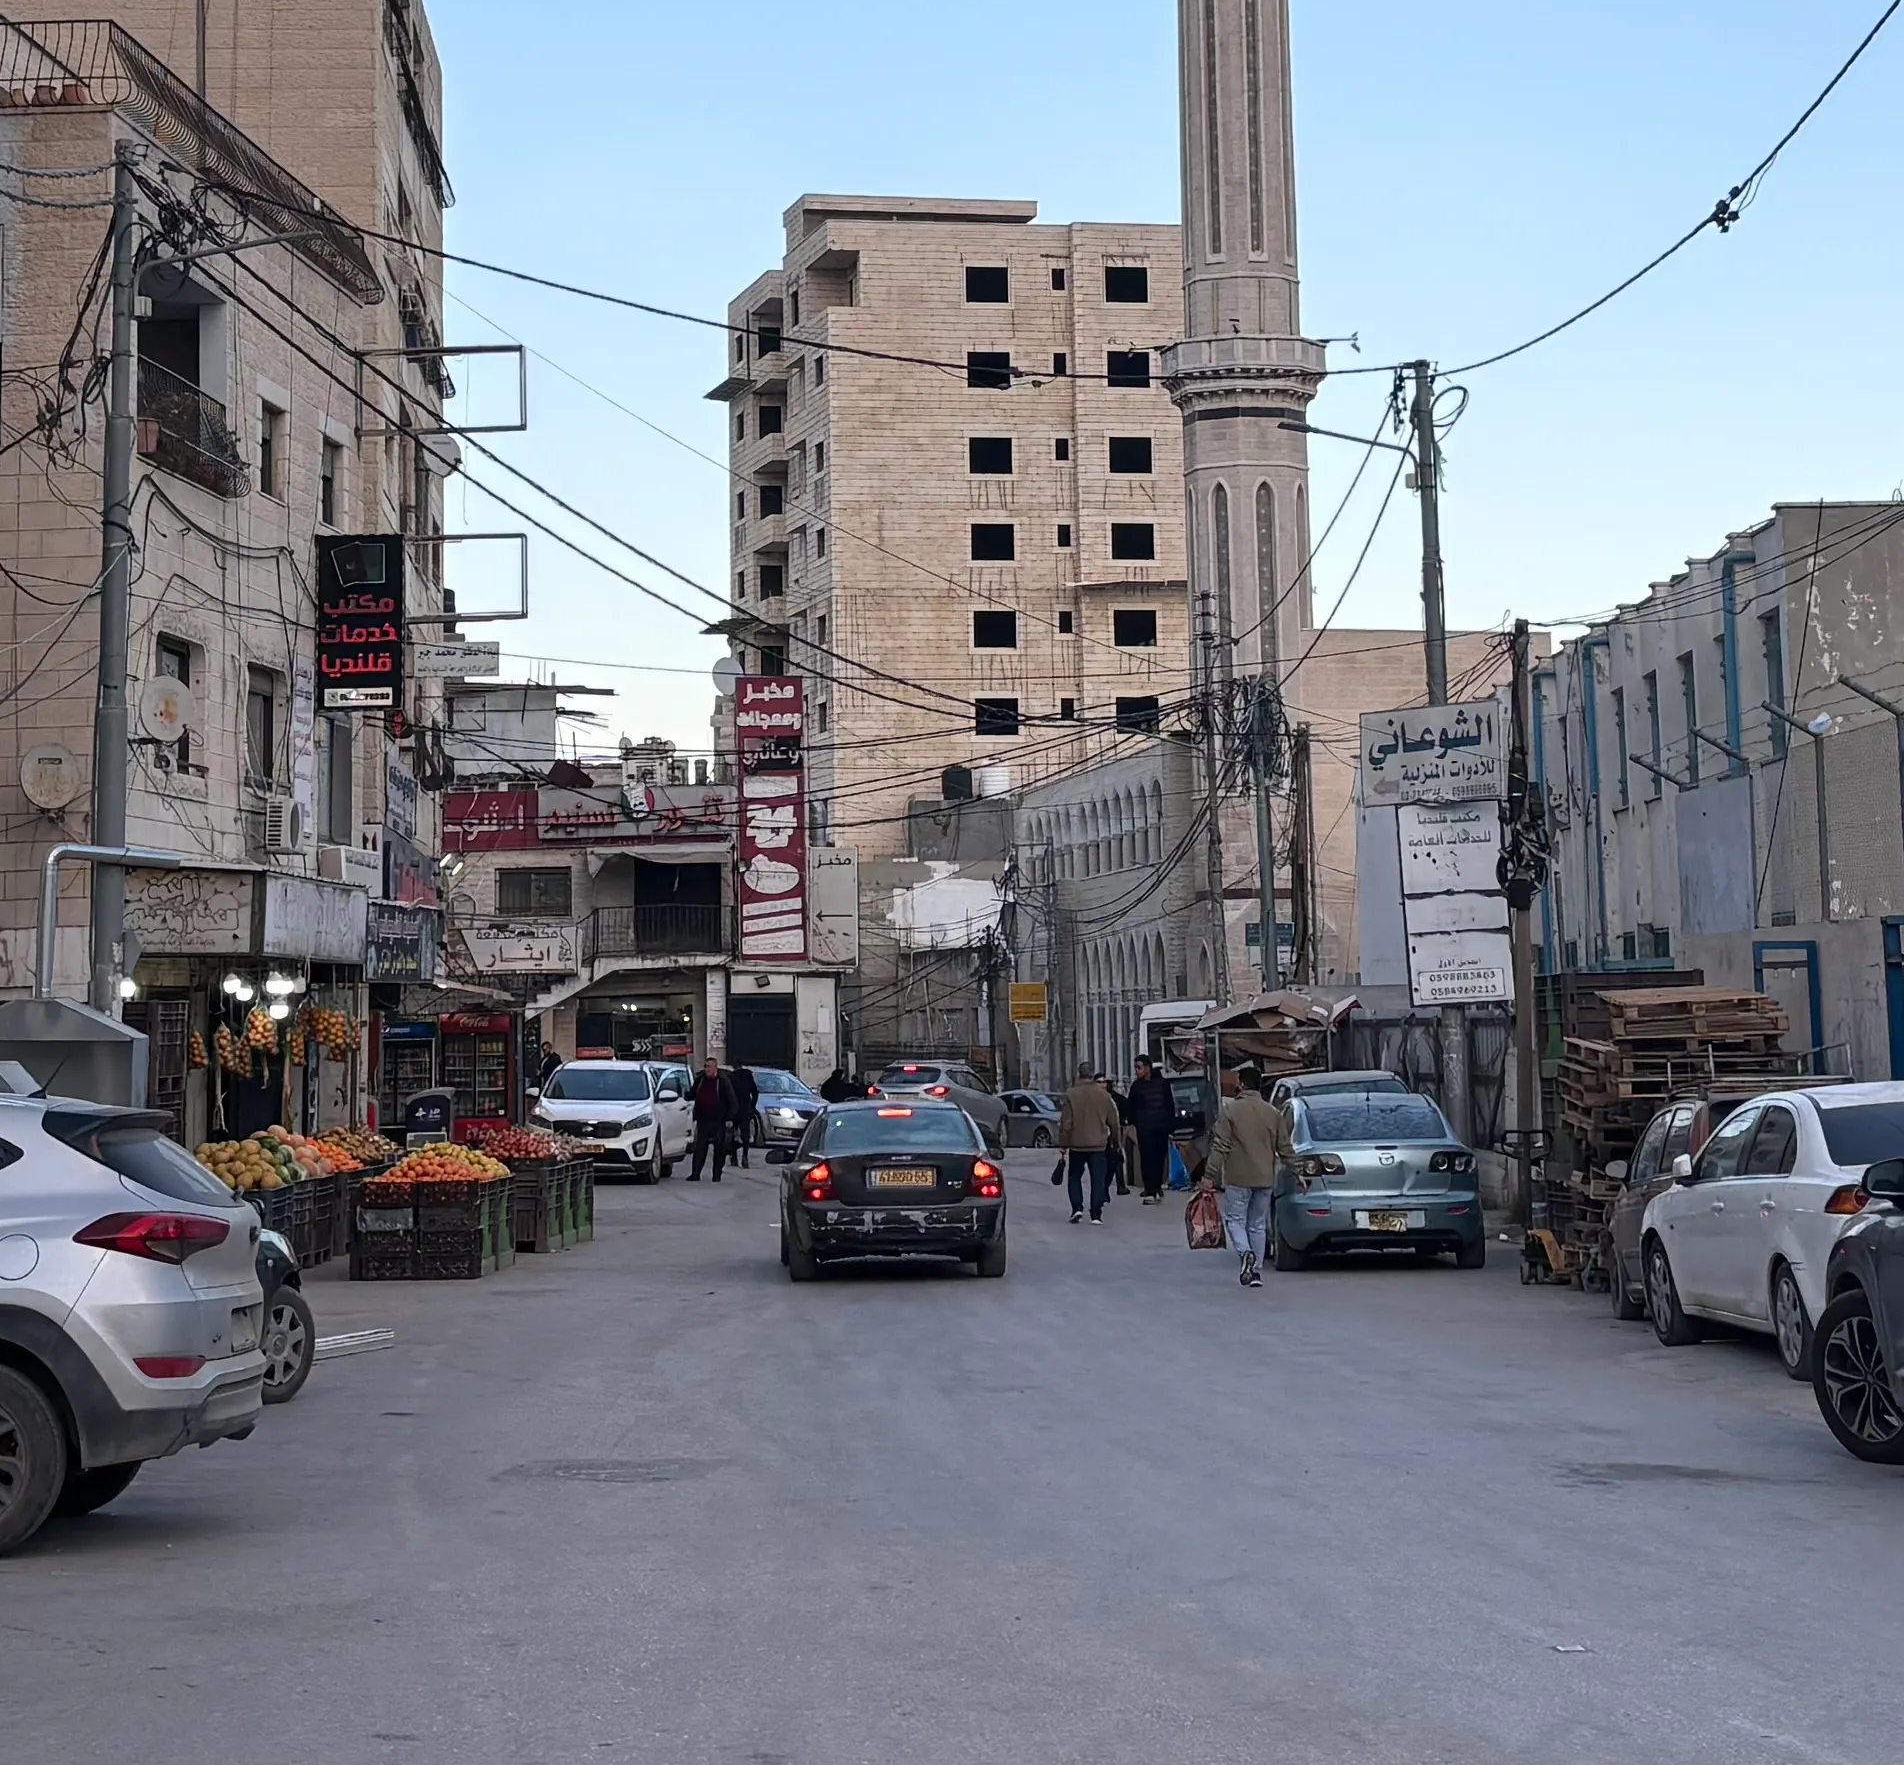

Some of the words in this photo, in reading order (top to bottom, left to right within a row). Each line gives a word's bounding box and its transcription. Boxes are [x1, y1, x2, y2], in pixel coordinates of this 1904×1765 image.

[323, 594, 395, 618] مكتب
[321, 623, 398, 644] خدمات
[321, 652, 393, 678] قلنديا
[743, 682, 795, 705] مخبز
[1368, 709, 1493, 771] الشوعاني
[1401, 761, 1445, 786] المنزلية
[816, 854, 852, 869] مخبز
